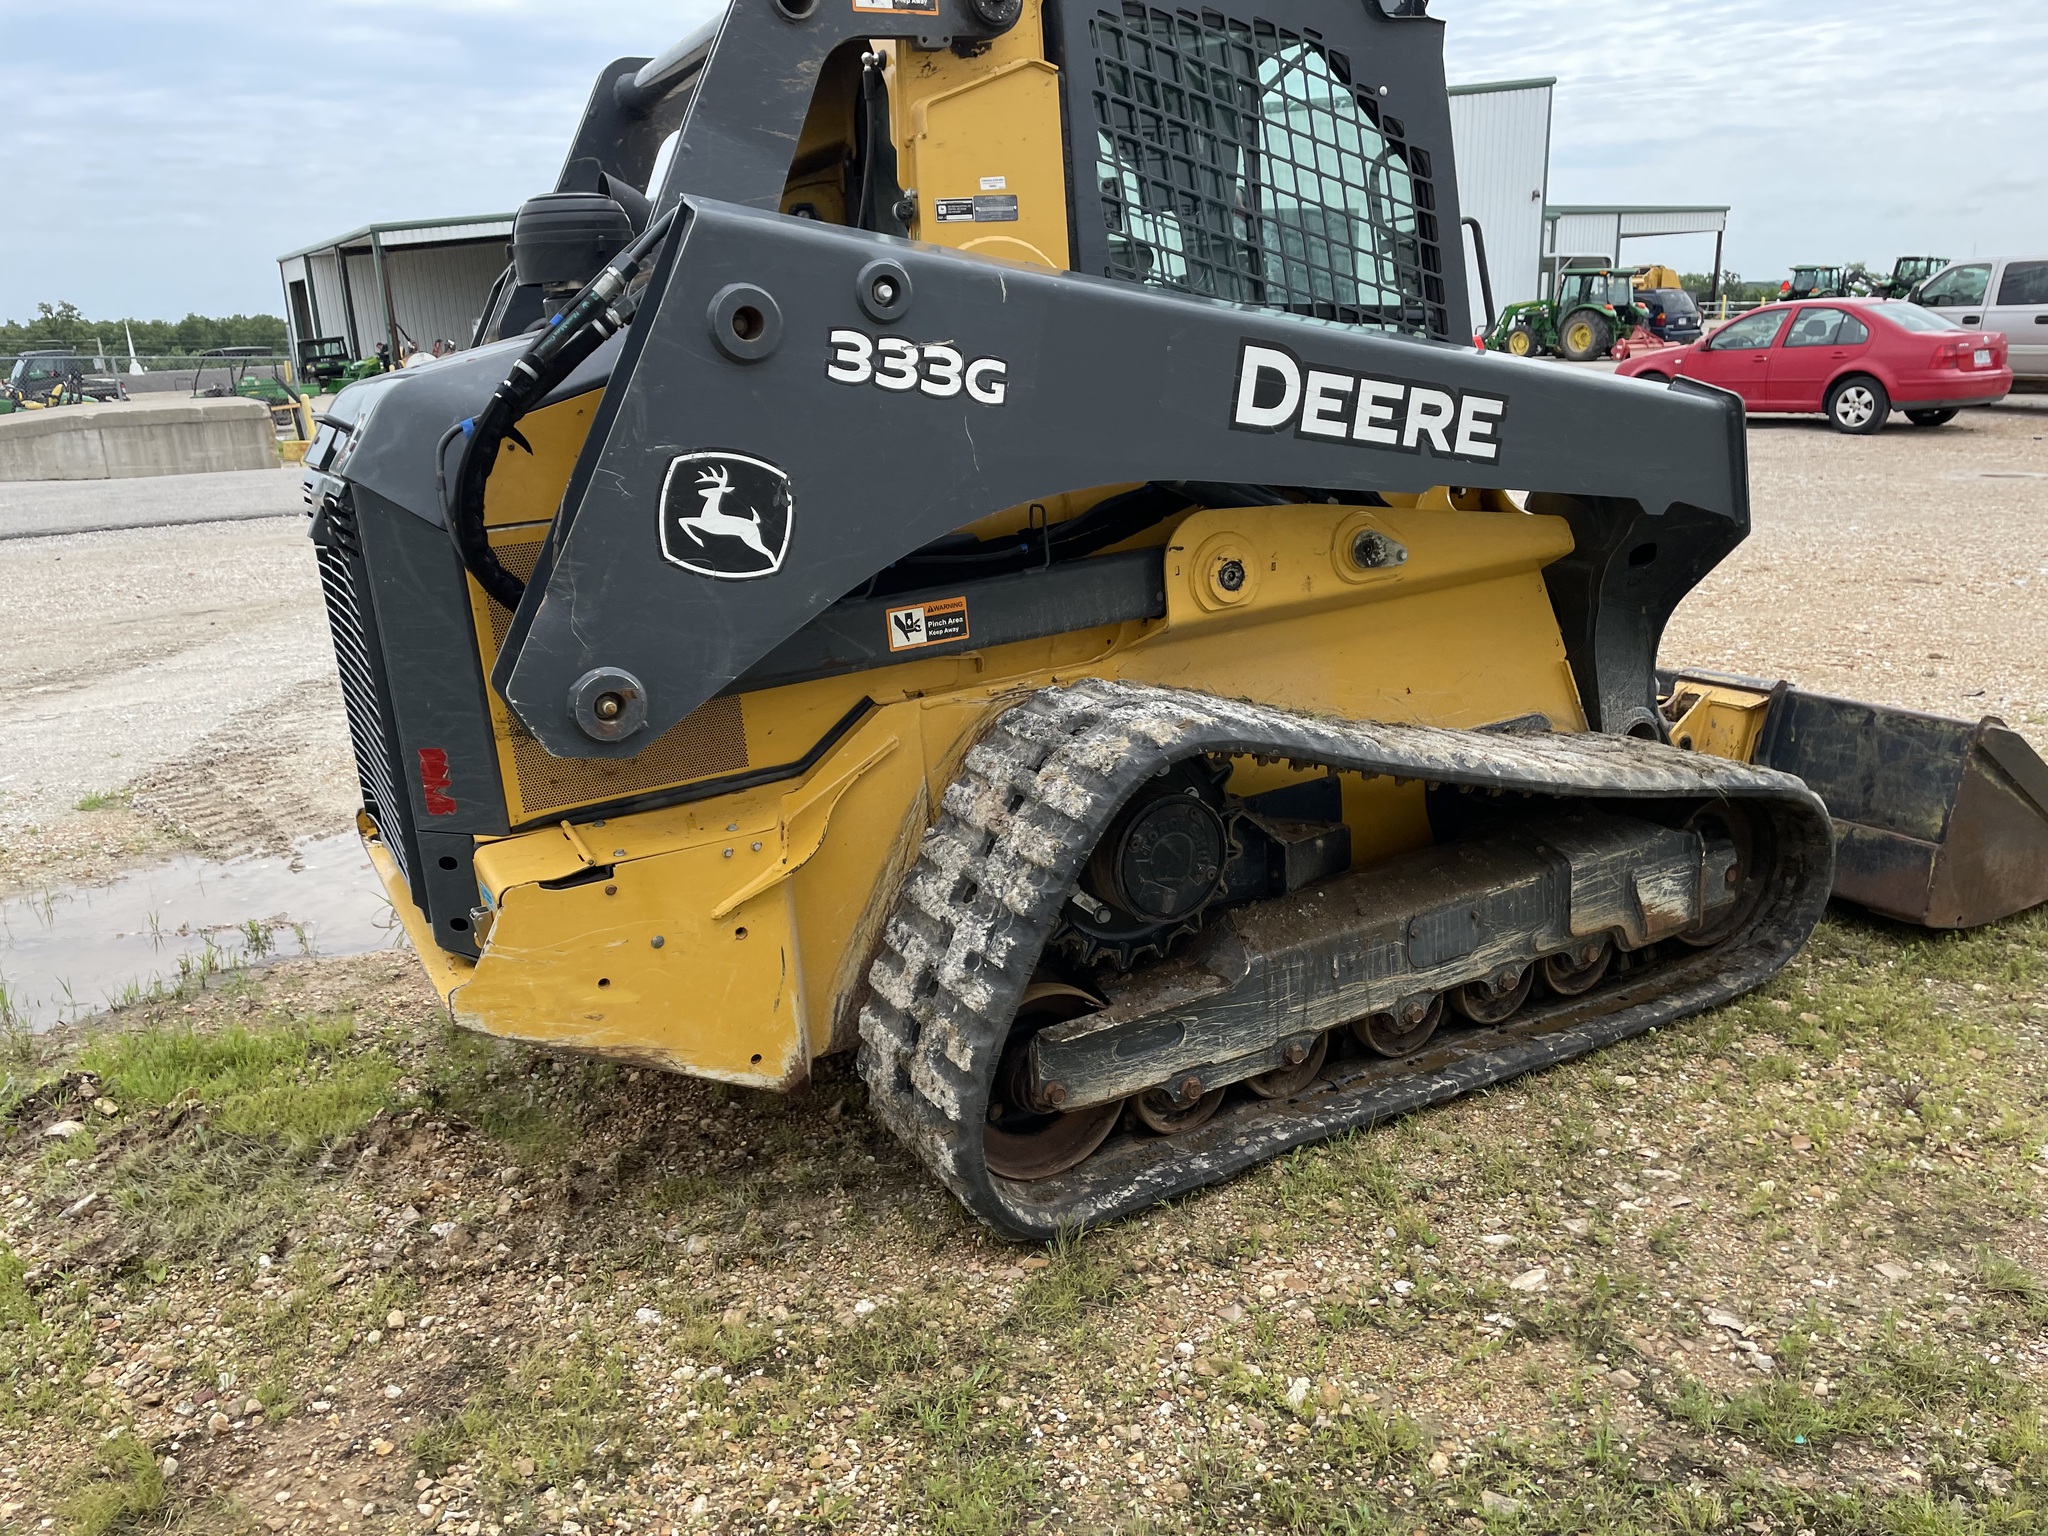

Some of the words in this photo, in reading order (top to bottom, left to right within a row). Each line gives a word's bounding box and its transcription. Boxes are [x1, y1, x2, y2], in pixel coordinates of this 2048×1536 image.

[828, 331, 1005, 404] 333G
[1236, 345, 1504, 458] DEERE
[932, 601, 964, 612] WARNING
[927, 618, 947, 628] Pinch
[947, 617, 964, 625] Area
[944, 626, 960, 635] Away
